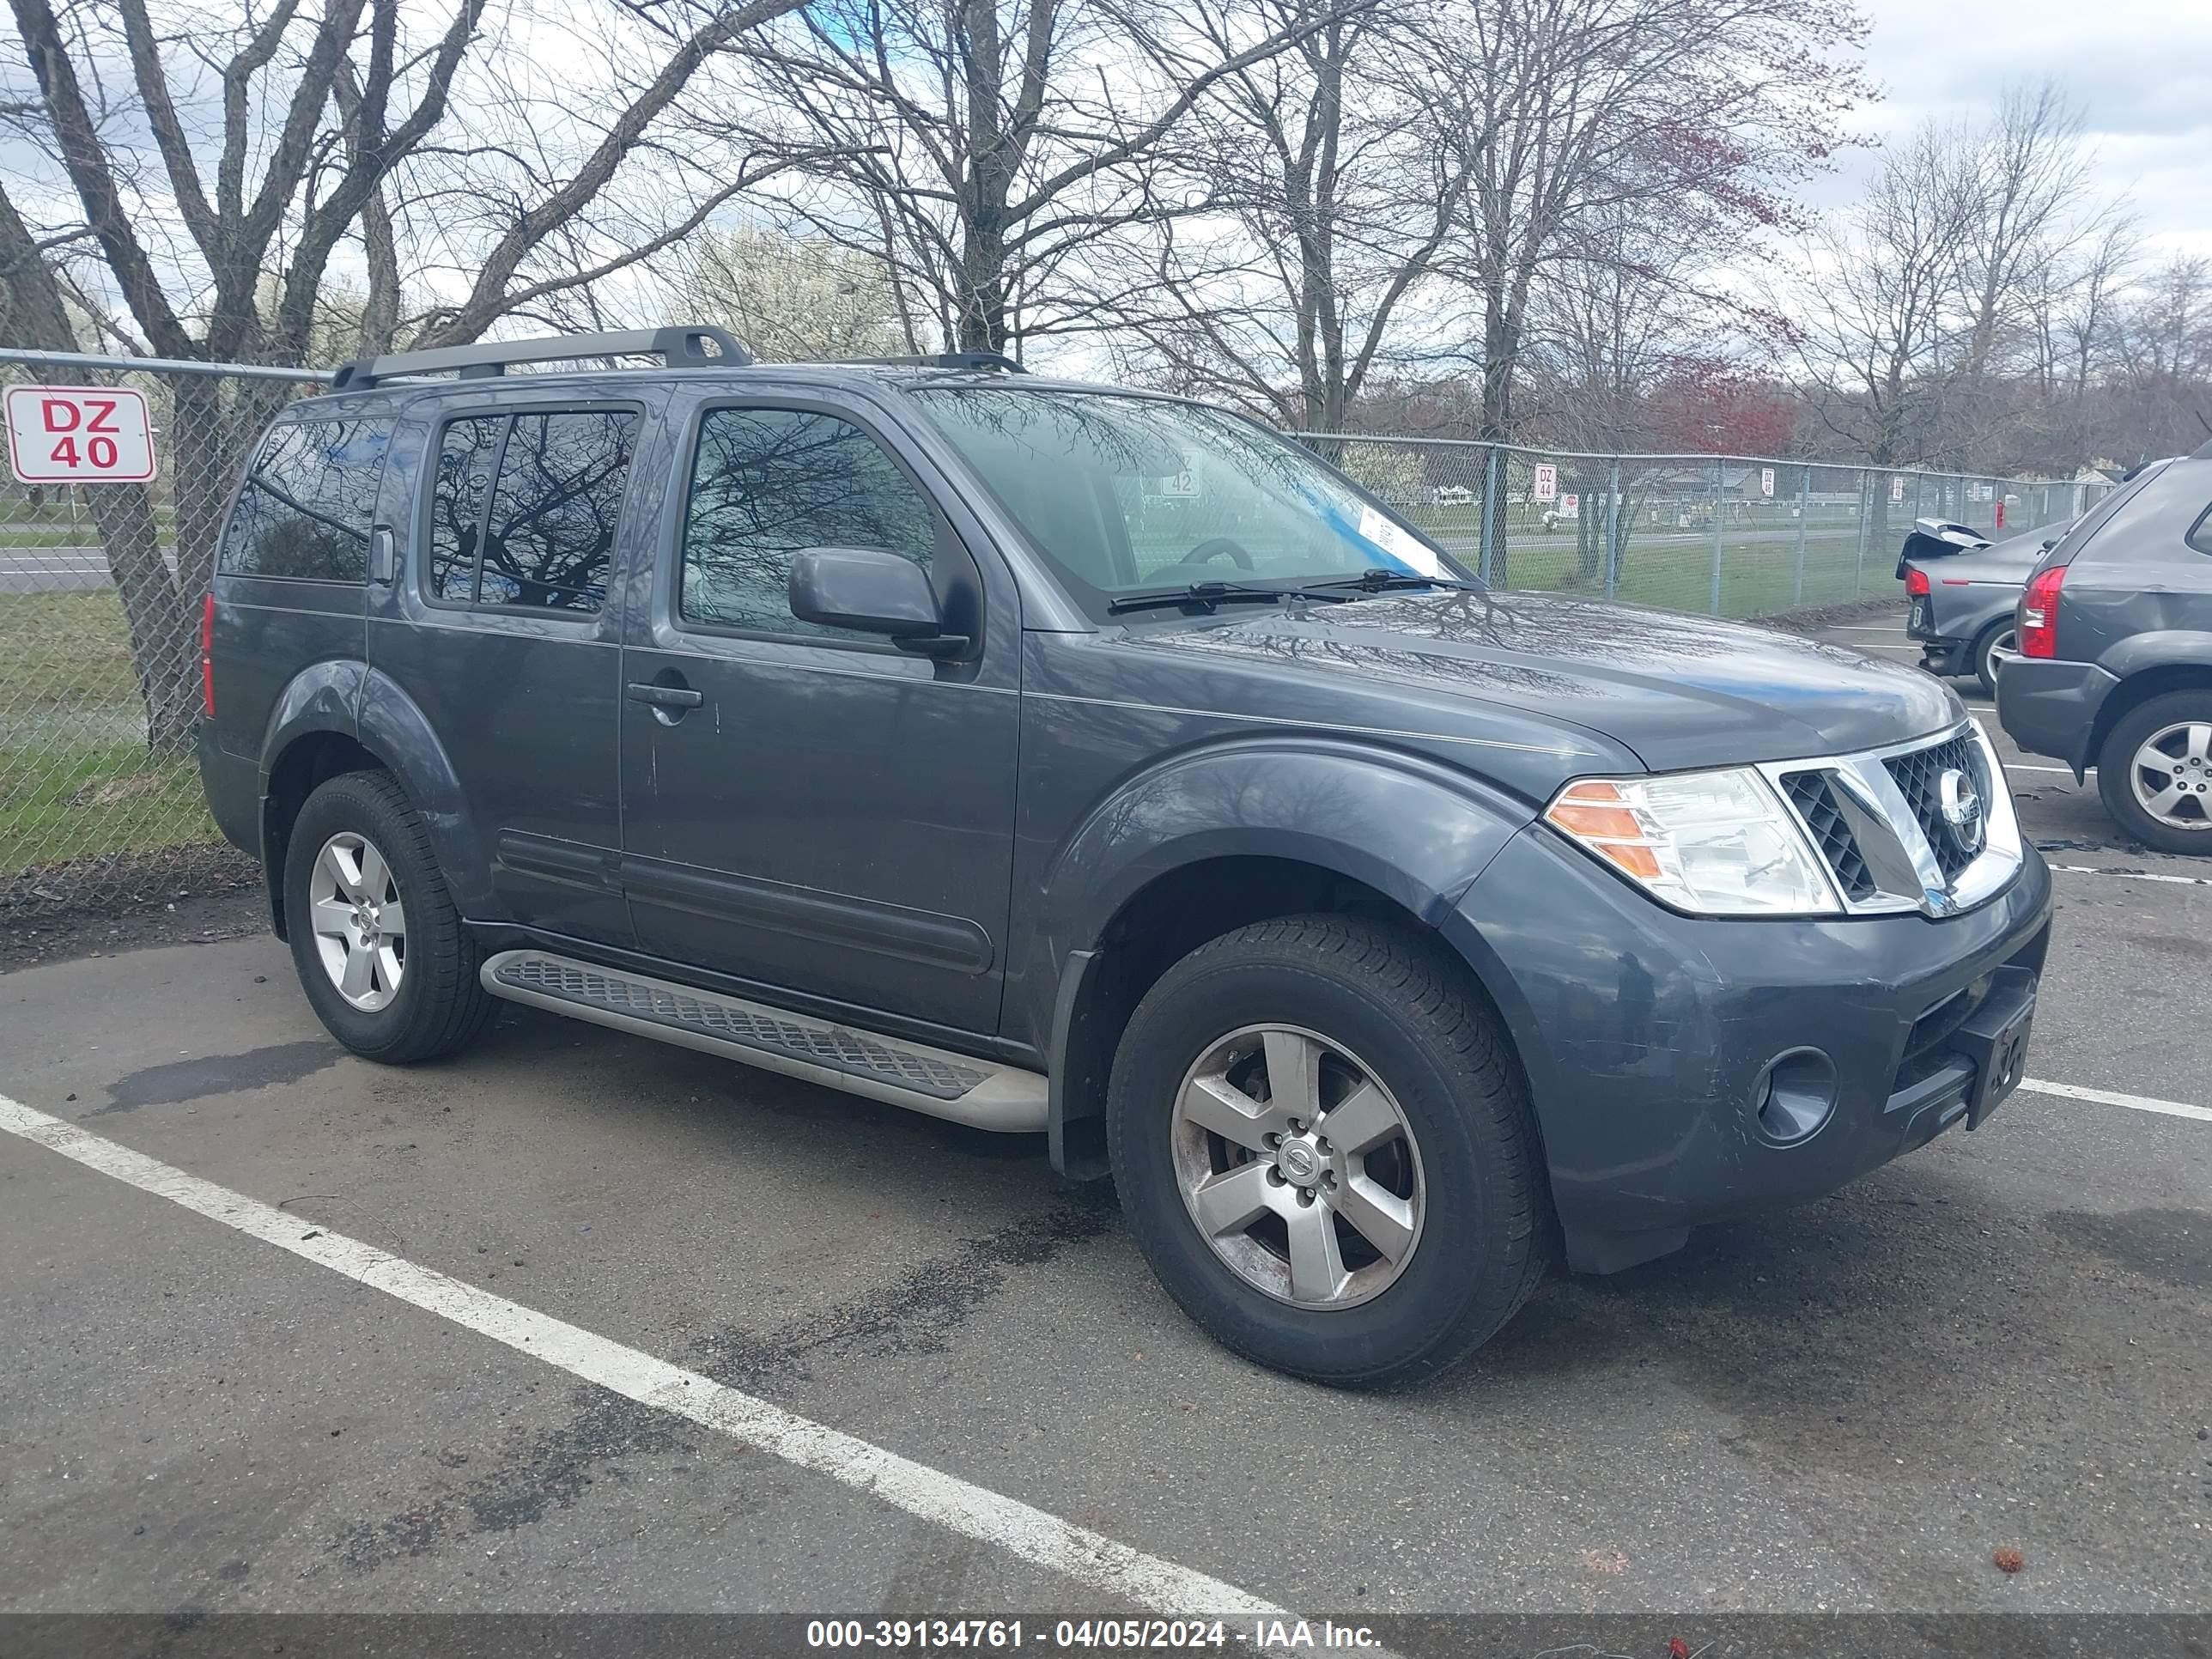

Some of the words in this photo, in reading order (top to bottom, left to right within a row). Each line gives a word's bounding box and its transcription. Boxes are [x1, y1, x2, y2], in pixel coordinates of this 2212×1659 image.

[41, 399, 120, 433] DZ
[51, 436, 118, 468] 40
[1172, 474, 1191, 491] 42
[1540, 469, 1553, 483] DZ
[1540, 483, 1551, 496] 44
